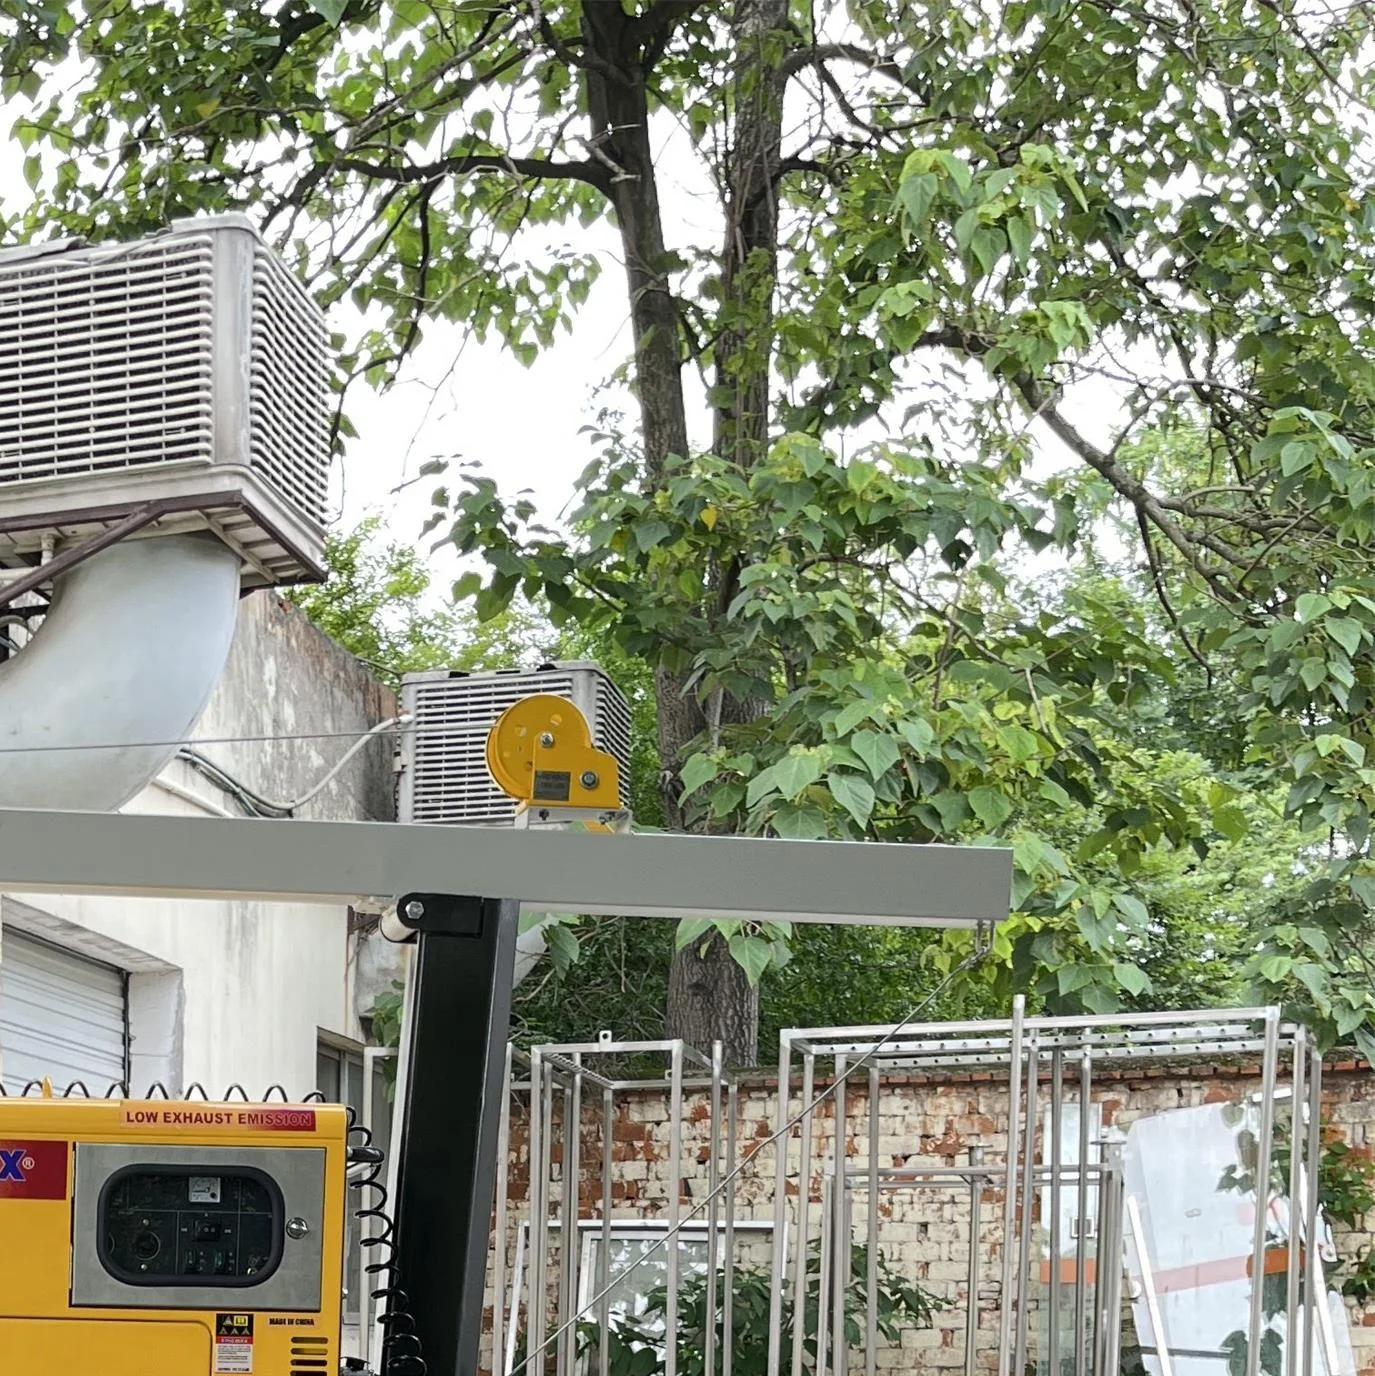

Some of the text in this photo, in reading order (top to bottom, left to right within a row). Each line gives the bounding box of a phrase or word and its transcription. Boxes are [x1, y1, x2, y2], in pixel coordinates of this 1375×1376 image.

[126, 1111, 312, 1126] LOW EXHAUST EMISSION
